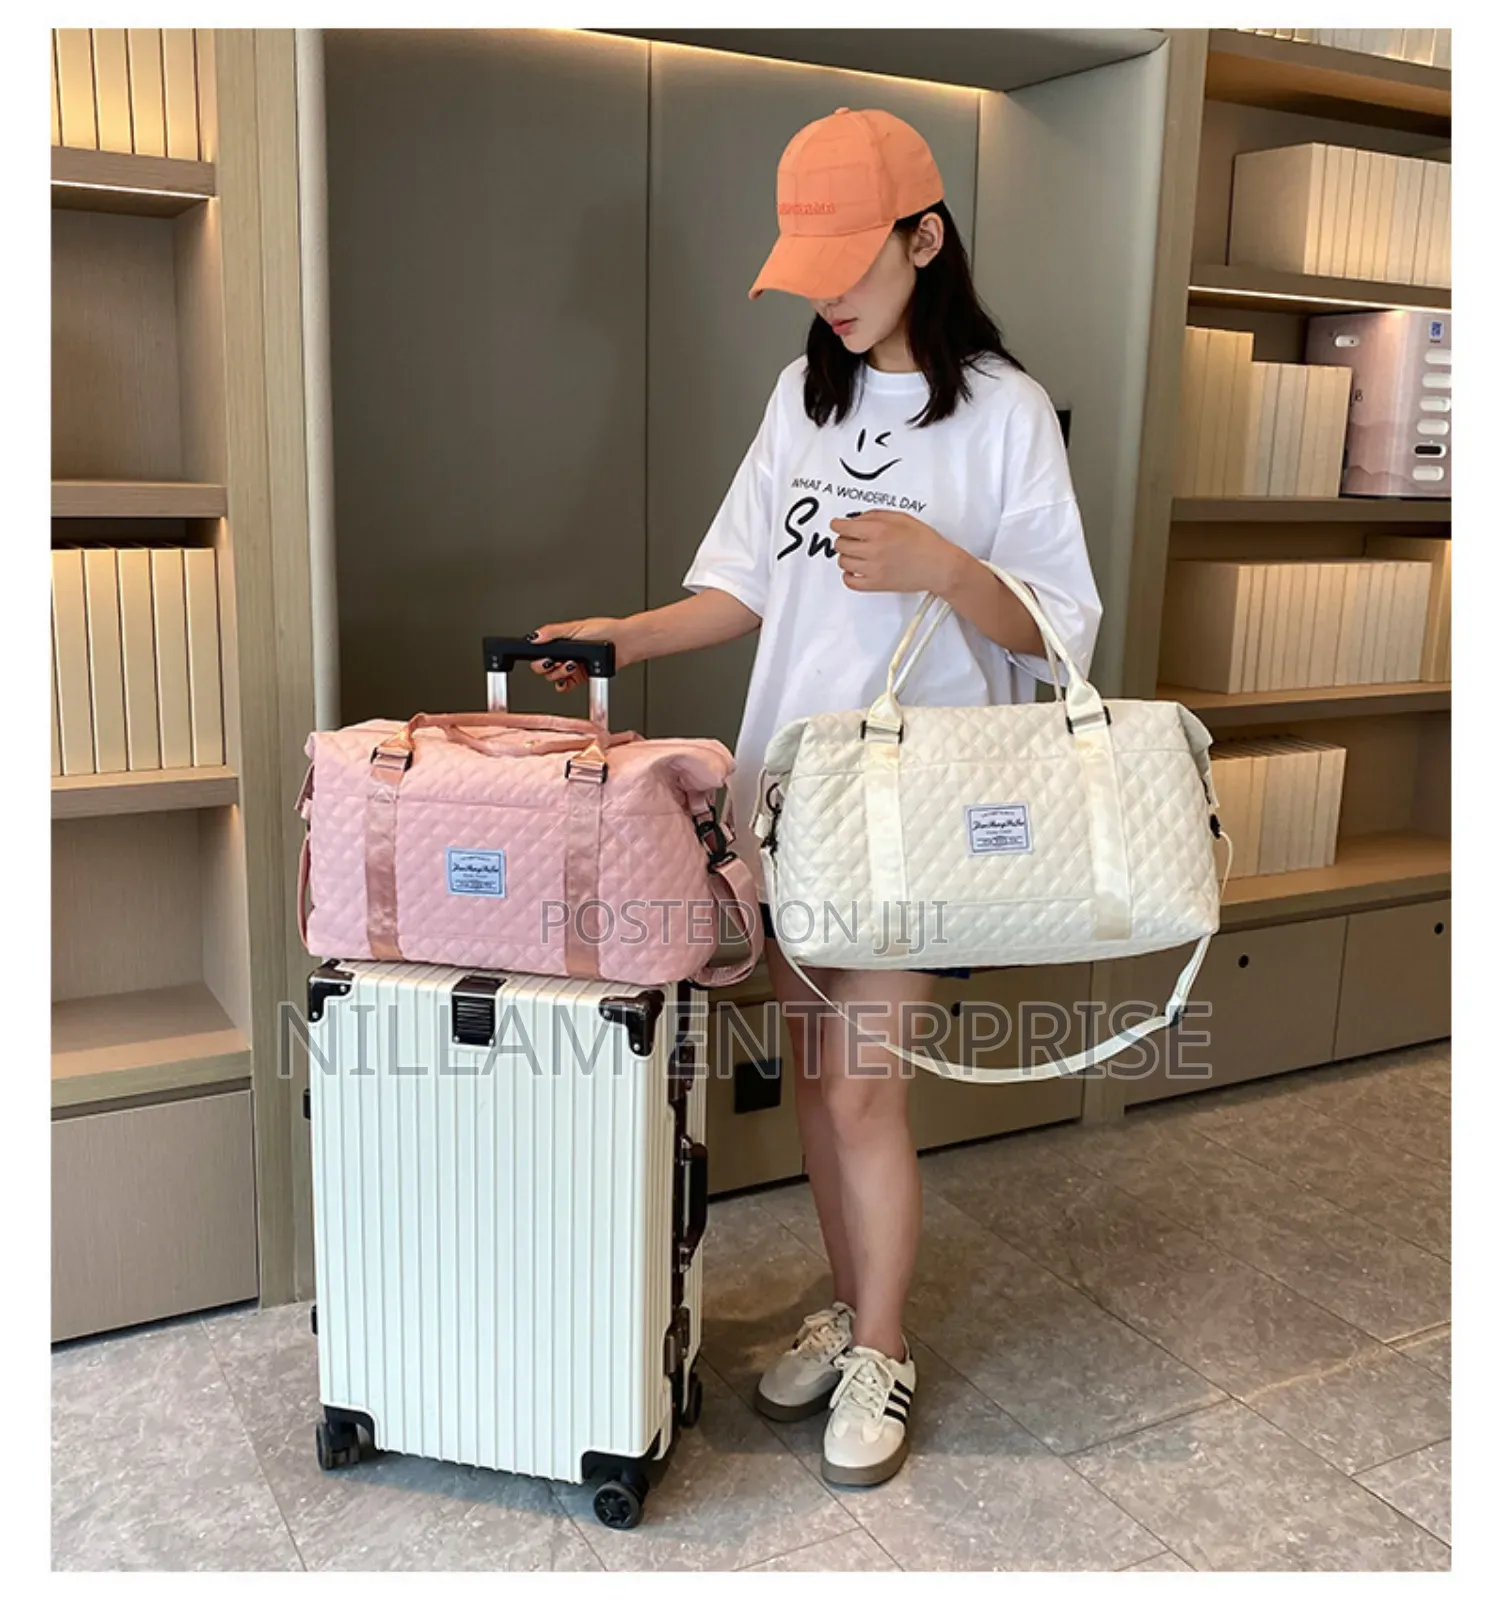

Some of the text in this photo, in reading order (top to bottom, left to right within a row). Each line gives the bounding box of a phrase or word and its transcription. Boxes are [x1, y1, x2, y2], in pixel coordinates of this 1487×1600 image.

[791, 477, 928, 513] WHAT A WONDERFUL DAY
